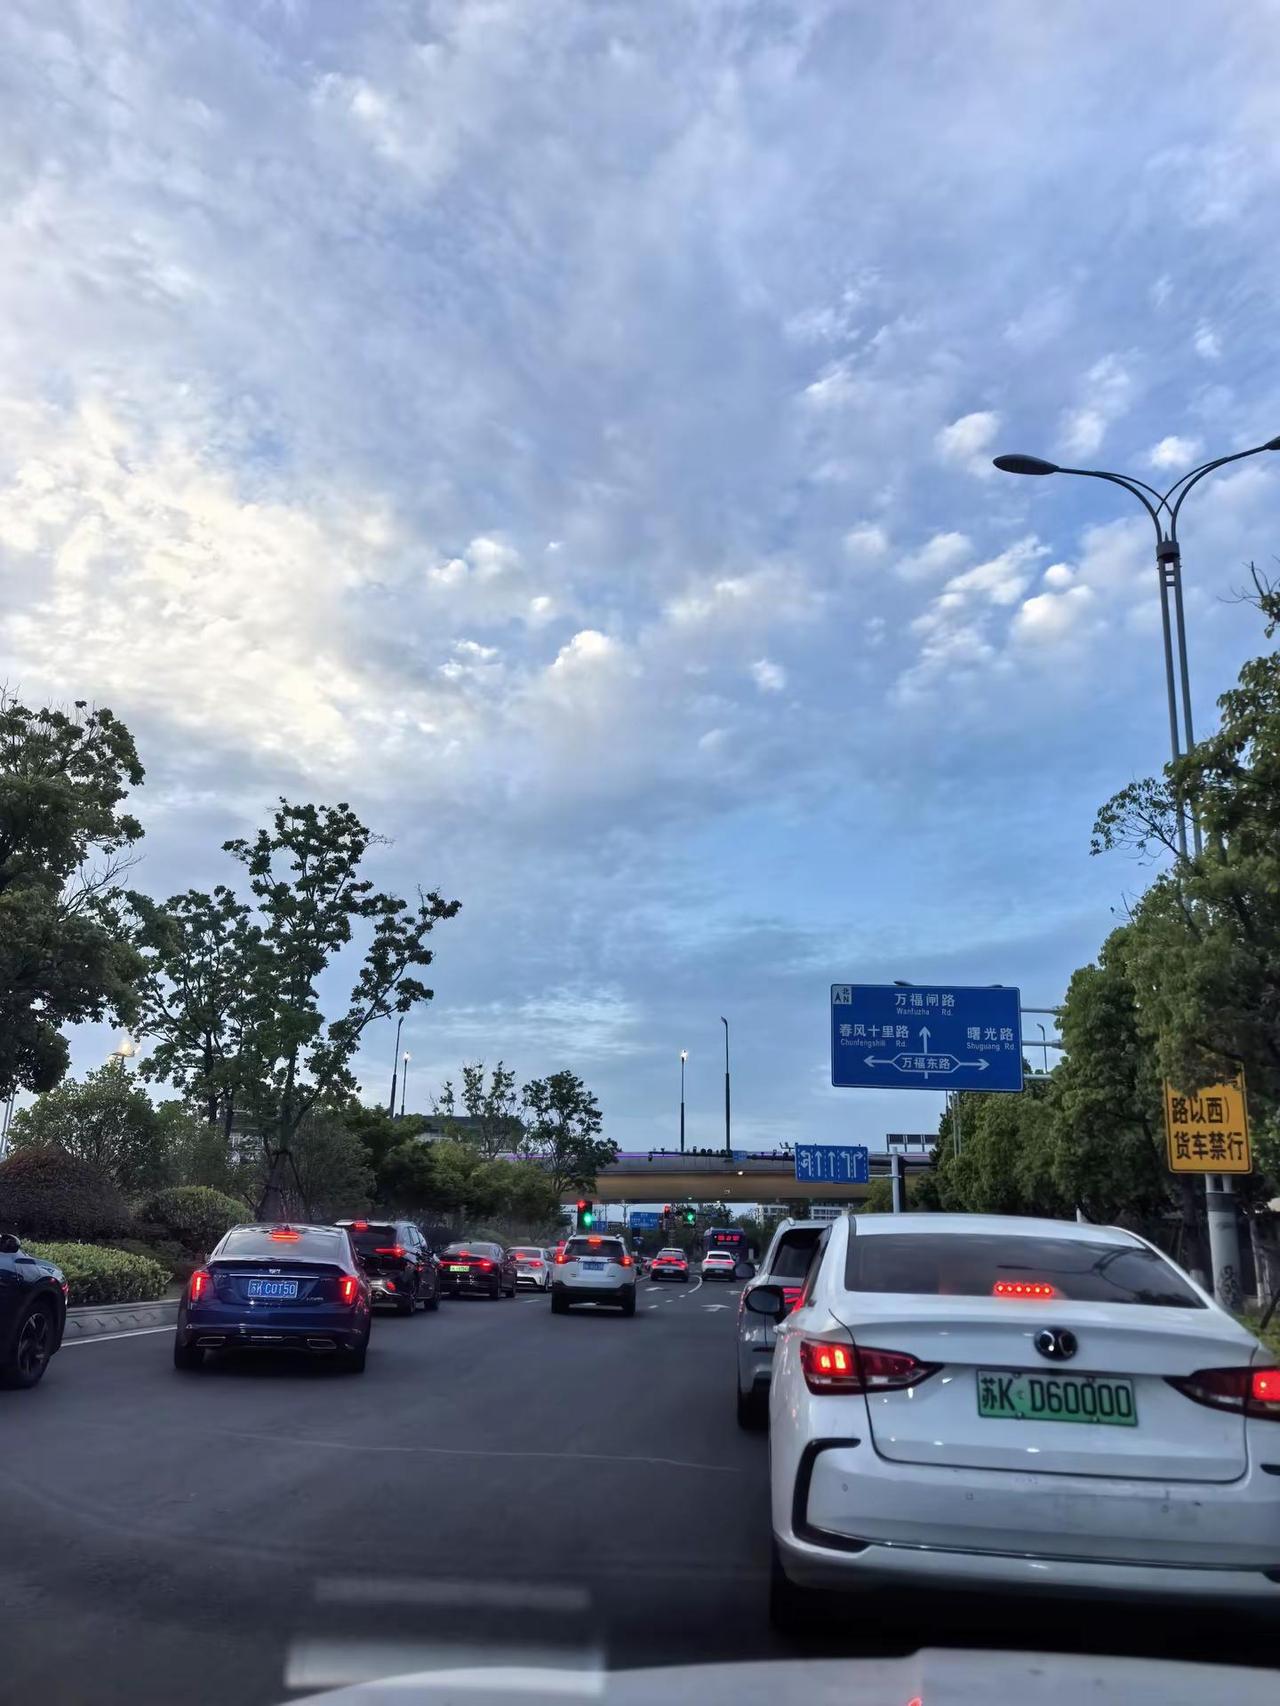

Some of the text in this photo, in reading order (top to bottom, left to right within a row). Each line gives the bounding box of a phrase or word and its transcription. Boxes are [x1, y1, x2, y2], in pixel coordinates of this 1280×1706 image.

[895, 993, 955, 1007] 万福闸路
[896, 1007, 930, 1015] Wanfuzha
[839, 1024, 909, 1038] 春风十里路
[967, 1027, 1014, 1040] 曙光路
[966, 1042, 1000, 1051] Shuguang
[901, 1057, 951, 1069] 万福东路
[1174, 1131, 1244, 1160] 货车禁行
